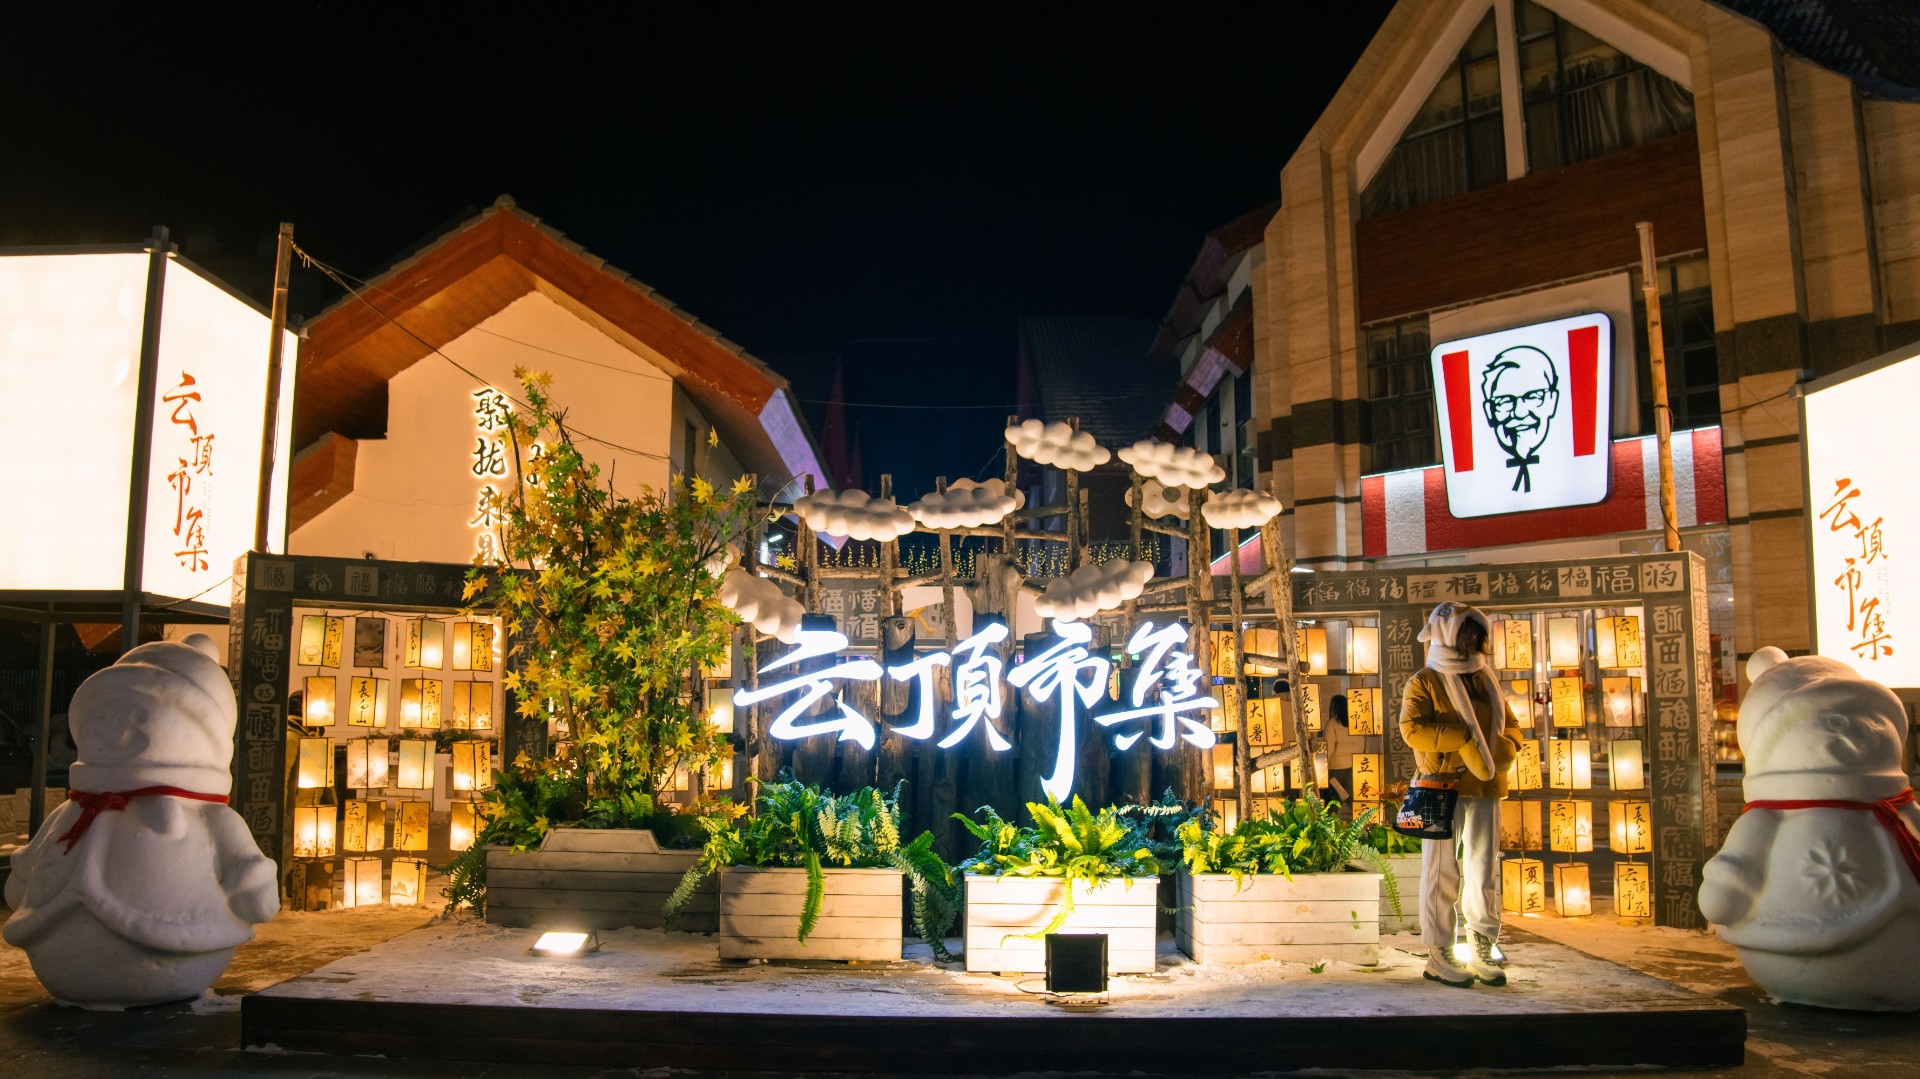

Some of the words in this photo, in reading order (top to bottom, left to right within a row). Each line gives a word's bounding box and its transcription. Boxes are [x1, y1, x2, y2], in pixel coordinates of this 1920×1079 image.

[163, 369, 215, 573] 云頂市集
[1819, 478, 1893, 660] 云頂市集
[735, 622, 1219, 802] 云頂市集
[1249, 702, 1263, 743] 大暑
[1554, 680, 1580, 726] 立夏
[1357, 757, 1376, 799] 立春
[1525, 866, 1542, 911] 夏至
